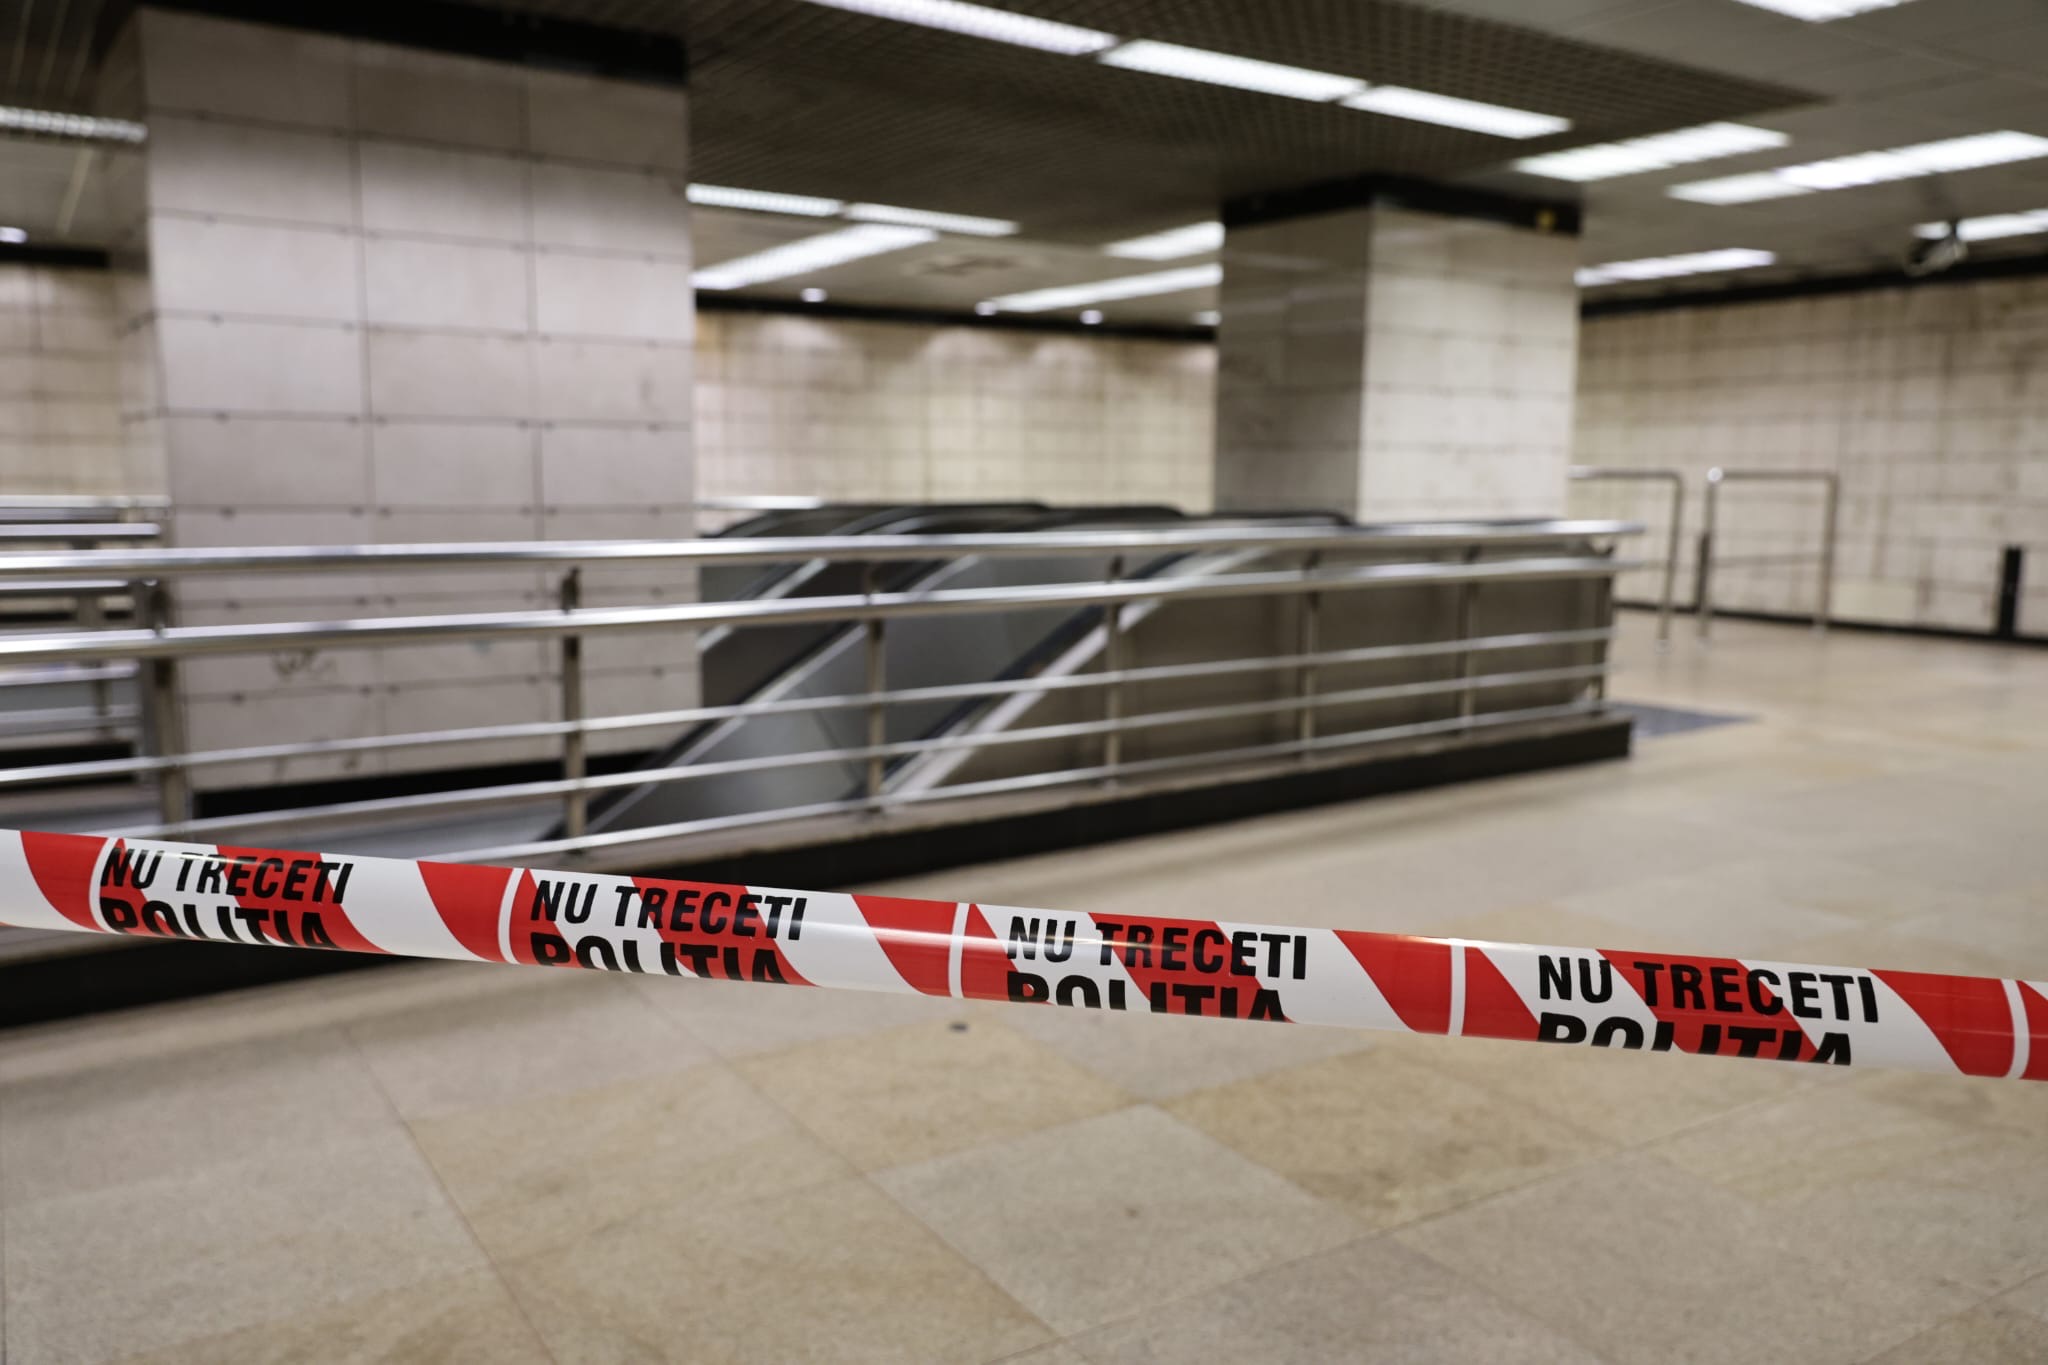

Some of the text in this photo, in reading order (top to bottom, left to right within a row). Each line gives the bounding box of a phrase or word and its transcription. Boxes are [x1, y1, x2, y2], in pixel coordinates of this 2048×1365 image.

[100, 848, 354, 904] NU TRECETI
[531, 880, 807, 941] NU TRECETI
[1007, 916, 1307, 980] NU TRECETI
[1539, 955, 1879, 1023] NU TRECETI
